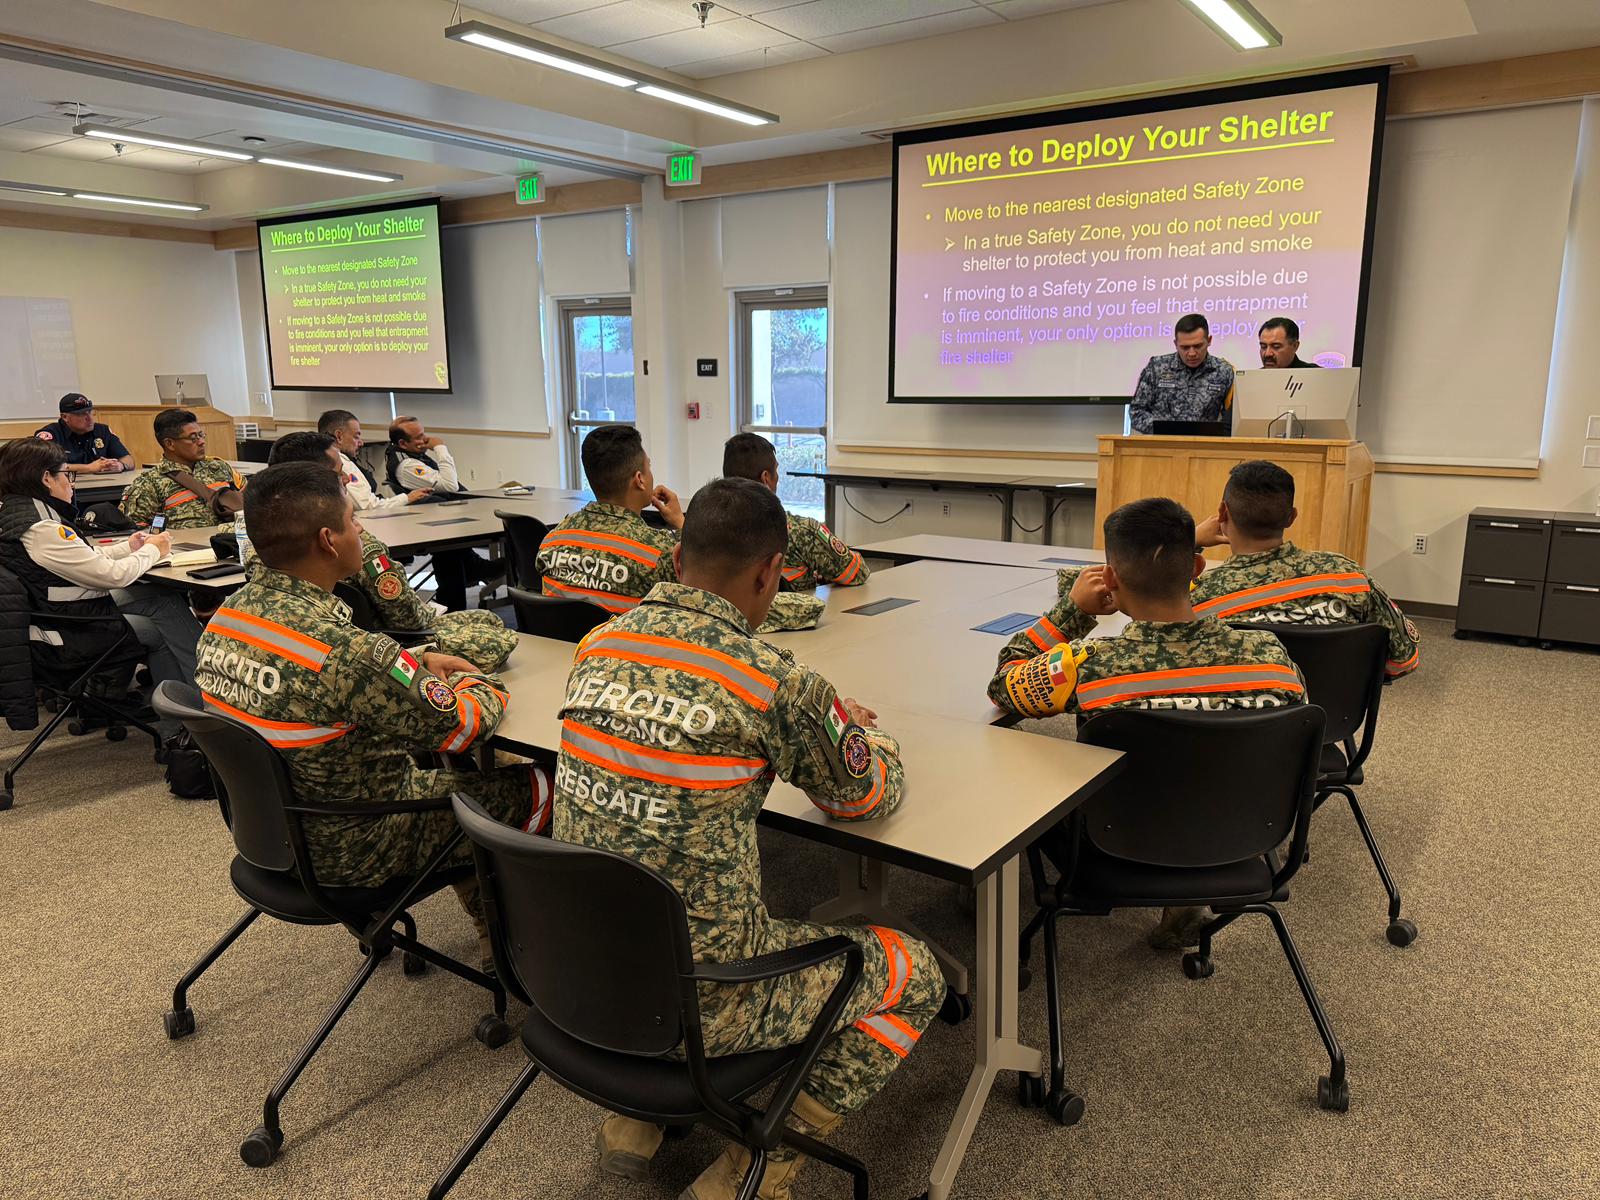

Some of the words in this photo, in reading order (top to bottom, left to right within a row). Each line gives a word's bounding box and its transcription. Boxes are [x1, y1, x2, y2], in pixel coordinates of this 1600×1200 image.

[926, 151, 1001, 176] Where
[1009, 145, 1034, 167] to
[1042, 134, 1135, 165] Deploy
[1143, 126, 1211, 151] Your
[1218, 110, 1334, 142] Shelter
[672, 155, 694, 182] EXIT
[519, 178, 538, 200] EXIT
[945, 207, 983, 222] Move
[987, 204, 1000, 219] to
[1005, 201, 1028, 217] the
[1034, 194, 1091, 214] nearest
[1096, 184, 1186, 209] designated
[1192, 181, 1250, 200] Safety
[1255, 176, 1304, 194] Zone
[271, 231, 302, 246] Where
[304, 228, 314, 242] to
[318, 224, 353, 244] Deploy
[355, 222, 381, 237] Your
[384, 216, 424, 234] Shelter
[964, 236, 976, 250] In
[981, 237, 990, 248] a
[995, 233, 1022, 248] true
[1027, 228, 1076, 245] Safety
[1080, 225, 1125, 241] Zone,
[1132, 223, 1161, 240] you
[1167, 218, 1188, 234] do
[1194, 215, 1222, 232] not
[1227, 210, 1272, 230] need
[1278, 210, 1322, 230] your
[282, 266, 298, 275] Move
[300, 266, 306, 274] to
[307, 264, 316, 273] the
[318, 261, 340, 272] nearest
[342, 258, 376, 272] designated
[378, 256, 400, 270] Safety
[401, 256, 418, 266] Zone
[962, 256, 1011, 272] shelter
[1015, 254, 1029, 268] to
[1034, 249, 1086, 270] protect
[1091, 250, 1120, 267] you
[1126, 244, 1162, 260] from
[1168, 240, 1206, 258] heat
[1210, 237, 1244, 255] and
[1250, 234, 1312, 253] smoke
[292, 284, 298, 293] In
[304, 284, 316, 292] true
[318, 281, 336, 294] Safety
[338, 280, 356, 290] Zone,
[357, 281, 369, 292] you
[370, 278, 379, 288] do
[380, 277, 392, 288] not
[393, 276, 409, 286] need
[410, 277, 427, 288] your
[943, 287, 952, 302] If
[955, 285, 1006, 302] moving
[1010, 284, 1024, 298] to
[1028, 286, 1037, 298] a
[1042, 280, 1092, 298] Safety
[1096, 278, 1136, 294] Zone
[1142, 276, 1156, 291] is
[1161, 274, 1188, 290] not
[1193, 270, 1268, 292] possible
[1272, 268, 1308, 286] due
[292, 297, 313, 308] shelter
[314, 297, 320, 306] to
[322, 296, 342, 308] protect
[344, 298, 355, 307] you
[356, 293, 371, 304] from
[372, 292, 387, 302] heat
[388, 291, 400, 302] and
[402, 290, 426, 301] smoke
[942, 309, 954, 323] to
[959, 308, 980, 322] fire
[984, 305, 1058, 320] conditions
[1063, 302, 1092, 318] and
[1097, 304, 1126, 320] you
[1131, 298, 1161, 315] feel
[1166, 296, 1197, 313] that
[1203, 292, 1308, 314] entrapment
[292, 316, 312, 326] moving
[314, 316, 320, 324] to
[327, 314, 346, 326] Safety
[348, 314, 364, 324] Zone
[365, 313, 371, 322] is
[372, 313, 382, 322] not
[384, 312, 412, 324] possible
[414, 311, 427, 321] due
[288, 330, 294, 340] to
[295, 330, 304, 339] fire
[306, 328, 336, 338] conditions
[336, 328, 348, 338] and
[350, 330, 362, 340] you
[362, 327, 374, 337] feel
[376, 326, 388, 337] that
[390, 326, 428, 338] entrapment
[941, 330, 952, 344] is
[956, 327, 1024, 344] imminent,
[1029, 328, 1062, 344] your
[1066, 324, 1098, 342] only
[1104, 322, 1152, 341] option
[1158, 322, 1172, 336] is
[1208, 319, 1257, 339] eploy
[289, 343, 294, 352] is
[296, 343, 324, 354] imminent,
[324, 344, 338, 354] your
[339, 342, 352, 354] only
[354, 342, 373, 354] option
[374, 342, 380, 351] is
[381, 341, 388, 351] to
[389, 340, 412, 354] deploy
[414, 342, 429, 354] your
[940, 350, 962, 364] fire
[966, 349, 1013, 364] shelter
[290, 356, 300, 366] fire
[301, 356, 320, 366] shelter
[1285, 376, 1302, 398] hp
[1040, 654, 1054, 694] AYUDA
[556, 763, 669, 823] RESCATE
